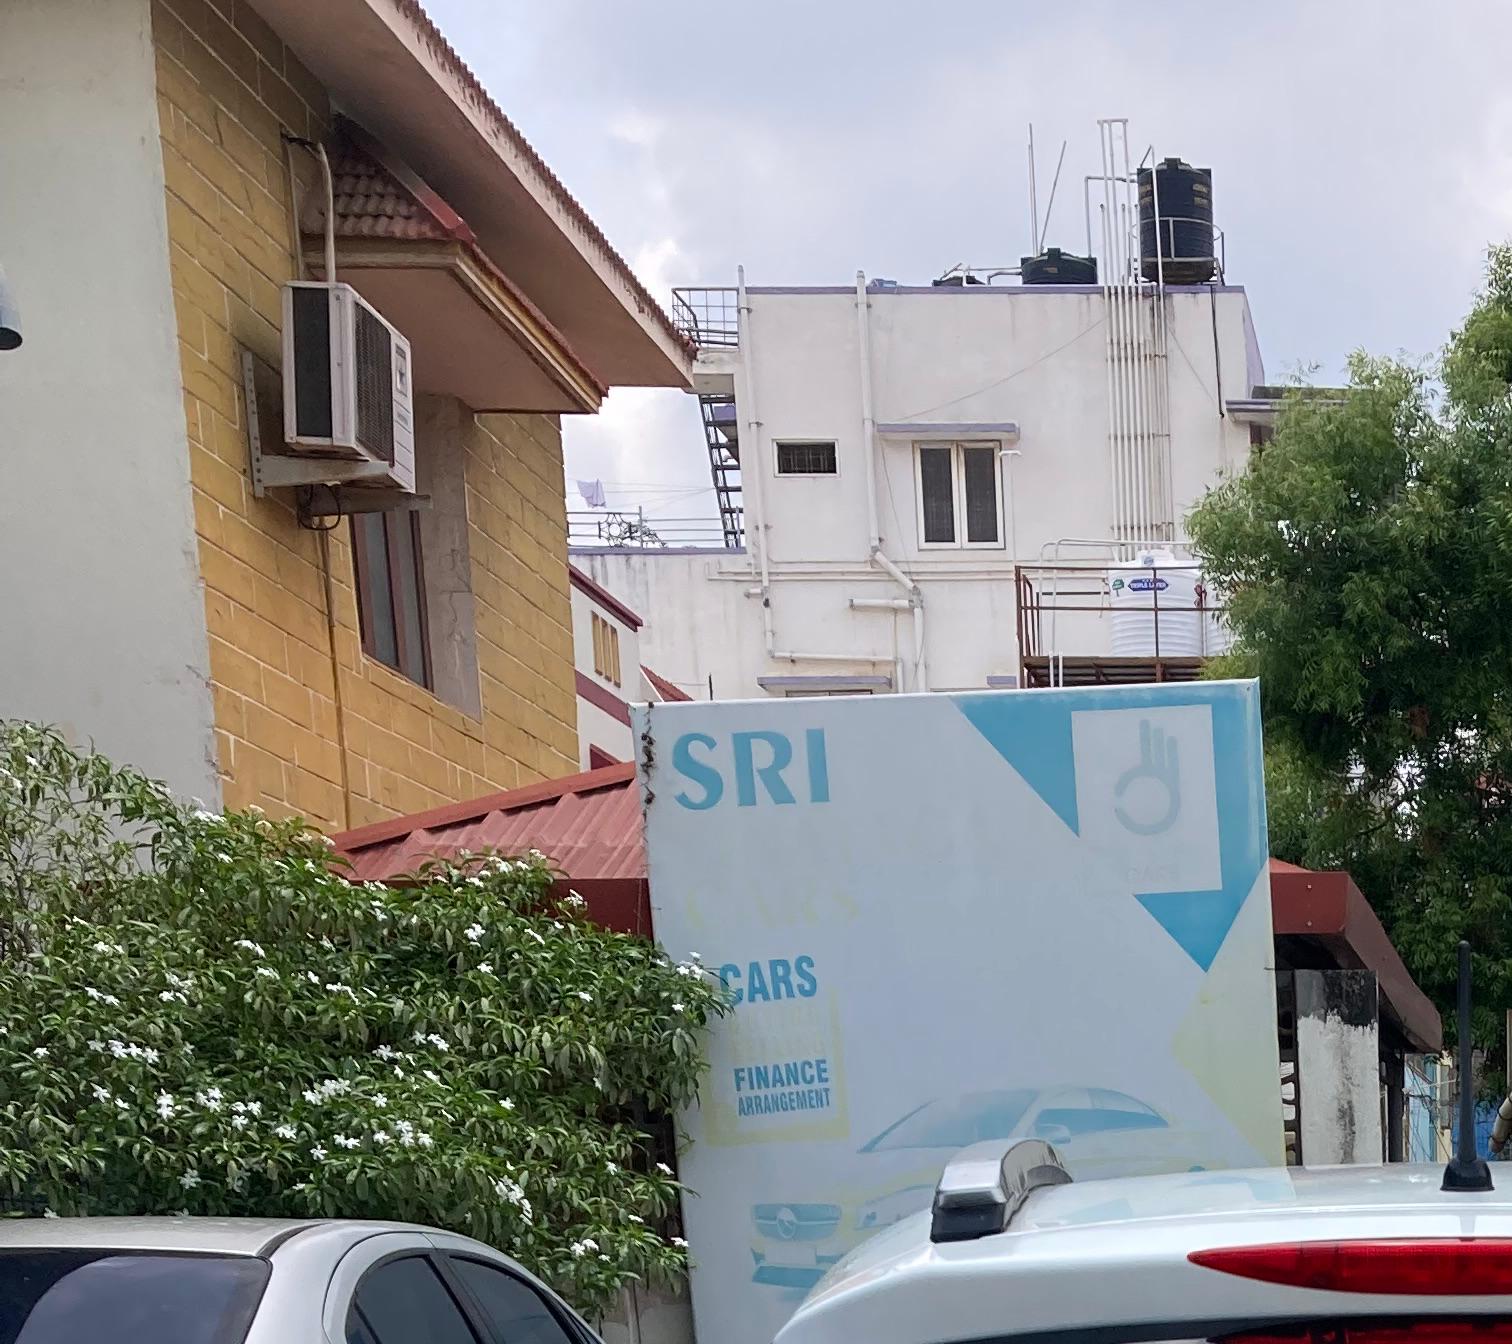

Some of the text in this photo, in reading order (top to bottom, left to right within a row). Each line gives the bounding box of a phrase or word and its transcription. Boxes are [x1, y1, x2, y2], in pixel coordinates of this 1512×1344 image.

[671, 727, 830, 811] SRI
[719, 955, 818, 1006] CARS
[733, 1059, 830, 1092] FINANCE
[737, 1087, 832, 1117] ARRANGEMENT
